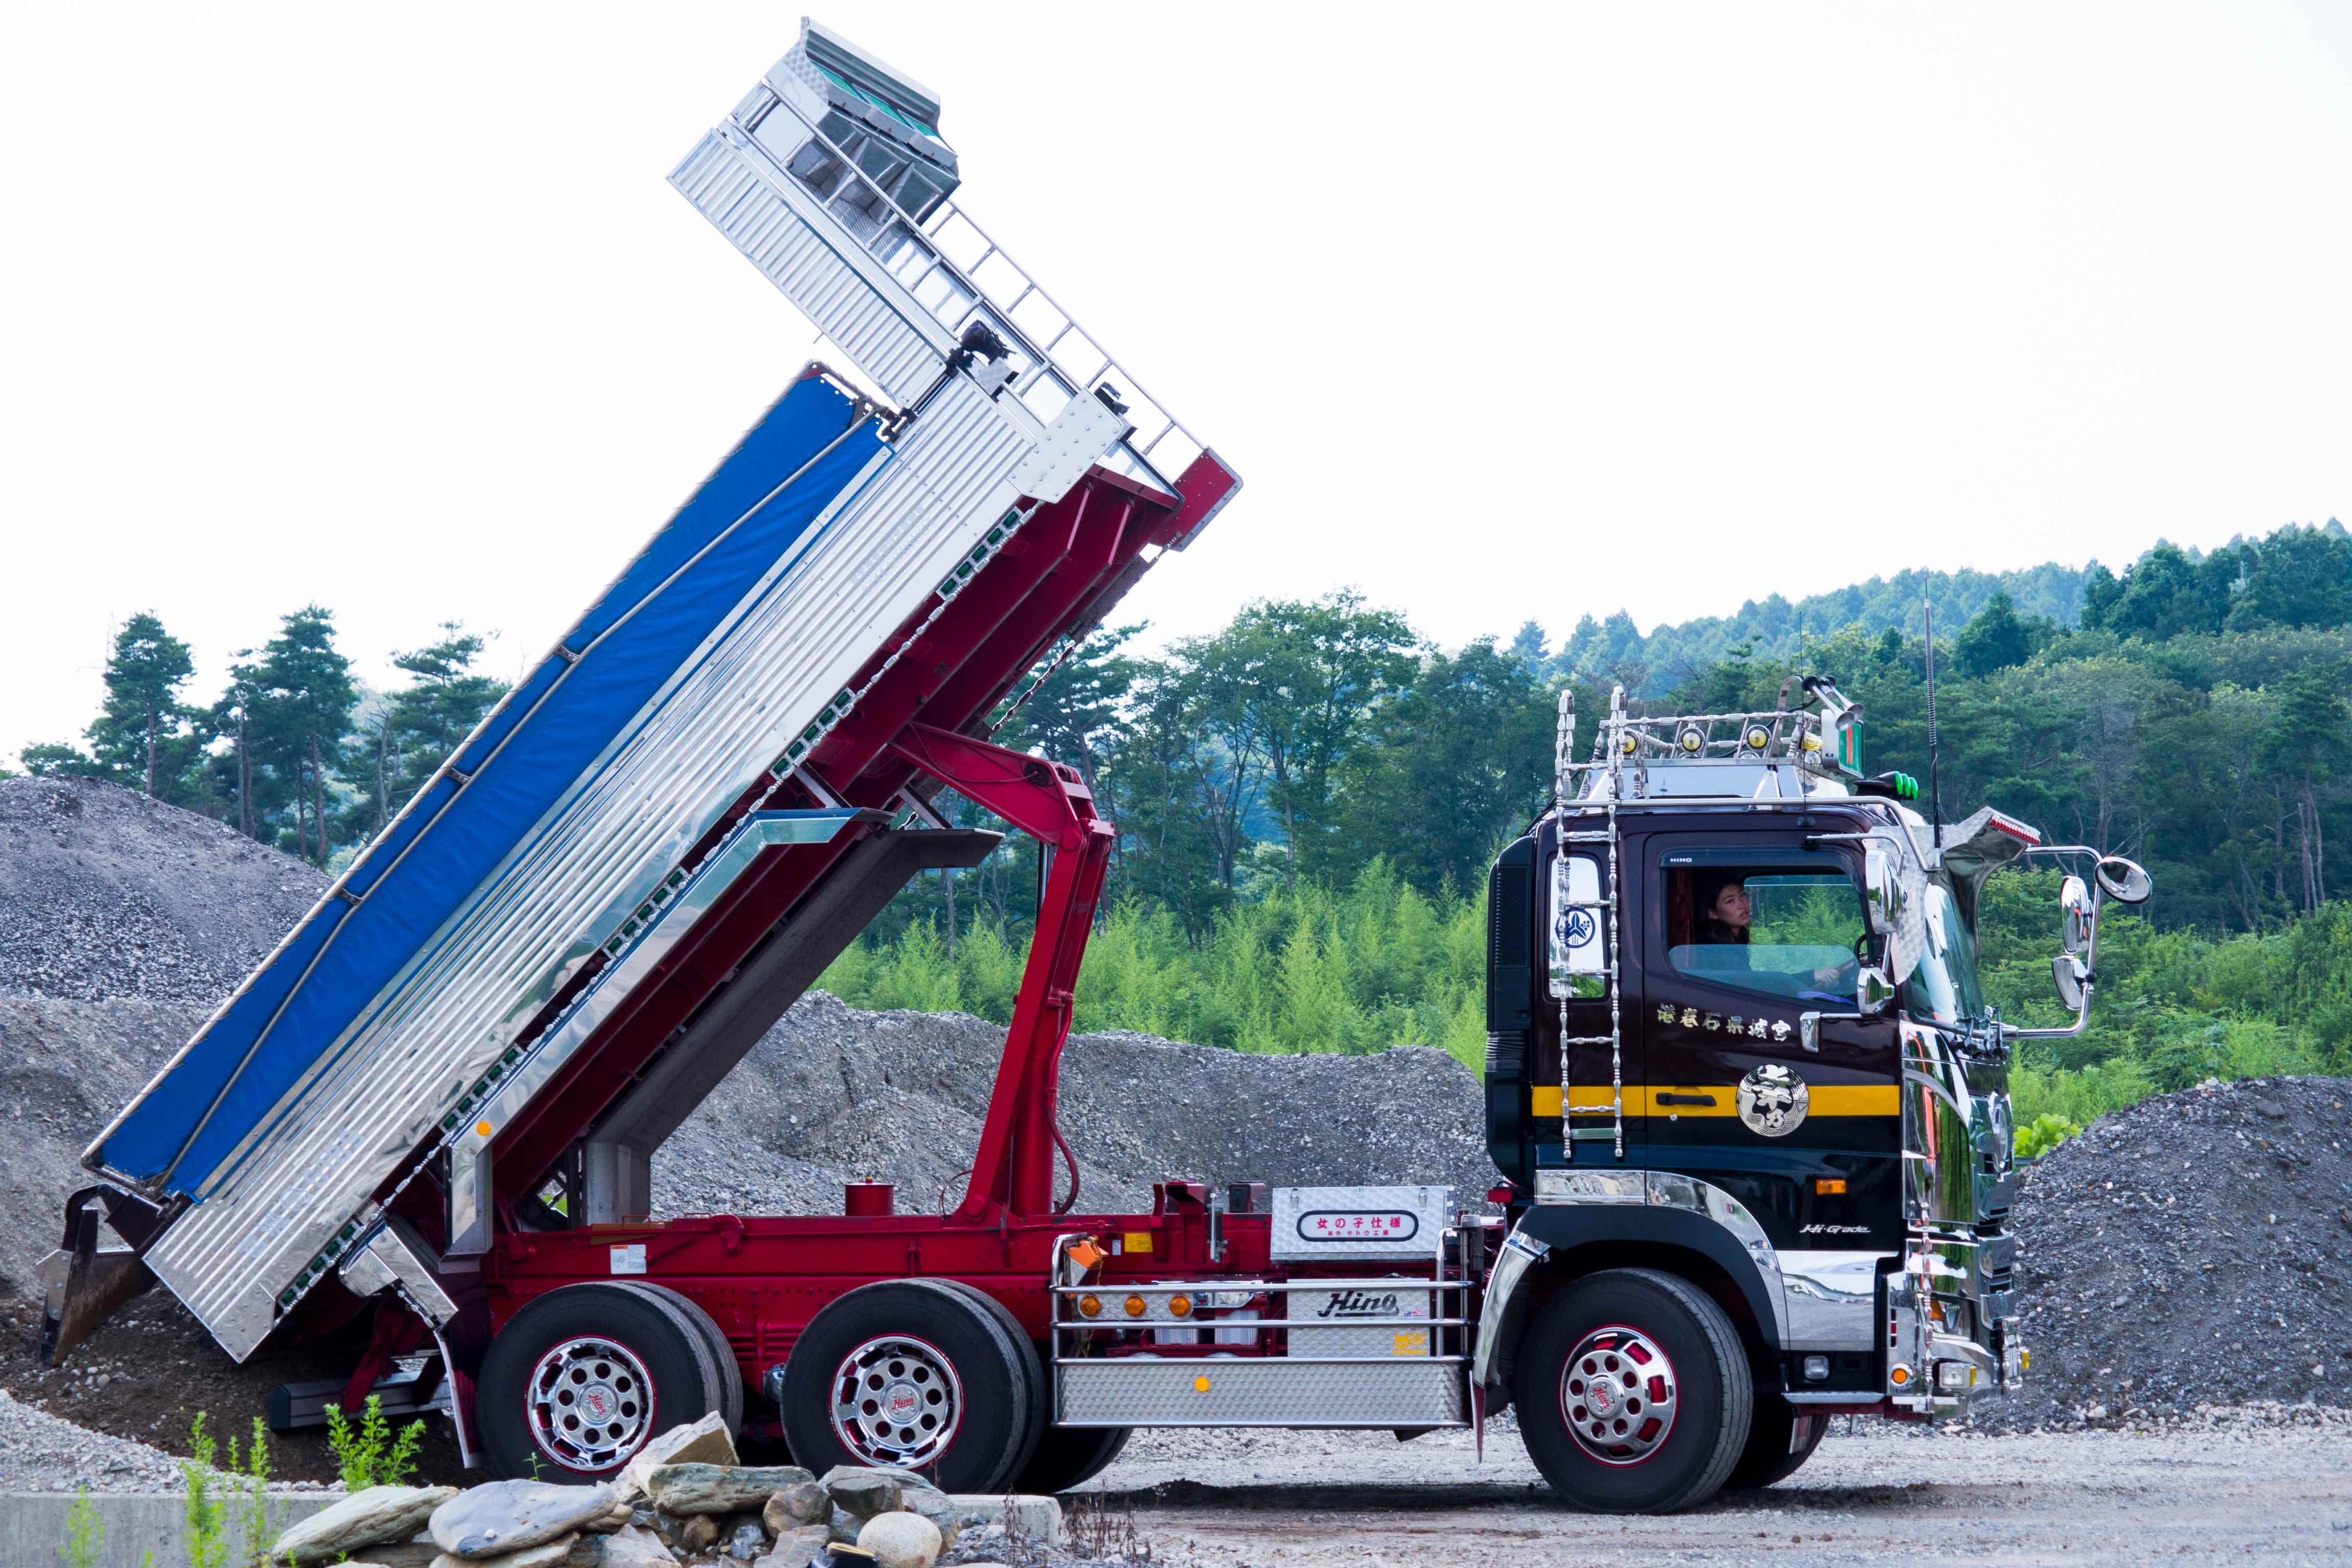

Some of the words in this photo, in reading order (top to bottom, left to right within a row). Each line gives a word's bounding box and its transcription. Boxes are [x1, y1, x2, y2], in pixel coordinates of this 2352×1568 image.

[1317, 1216, 1401, 1229] 女の子仕様
[1317, 1290, 1399, 1317] Hino
[891, 1396, 915, 1411] Hino
